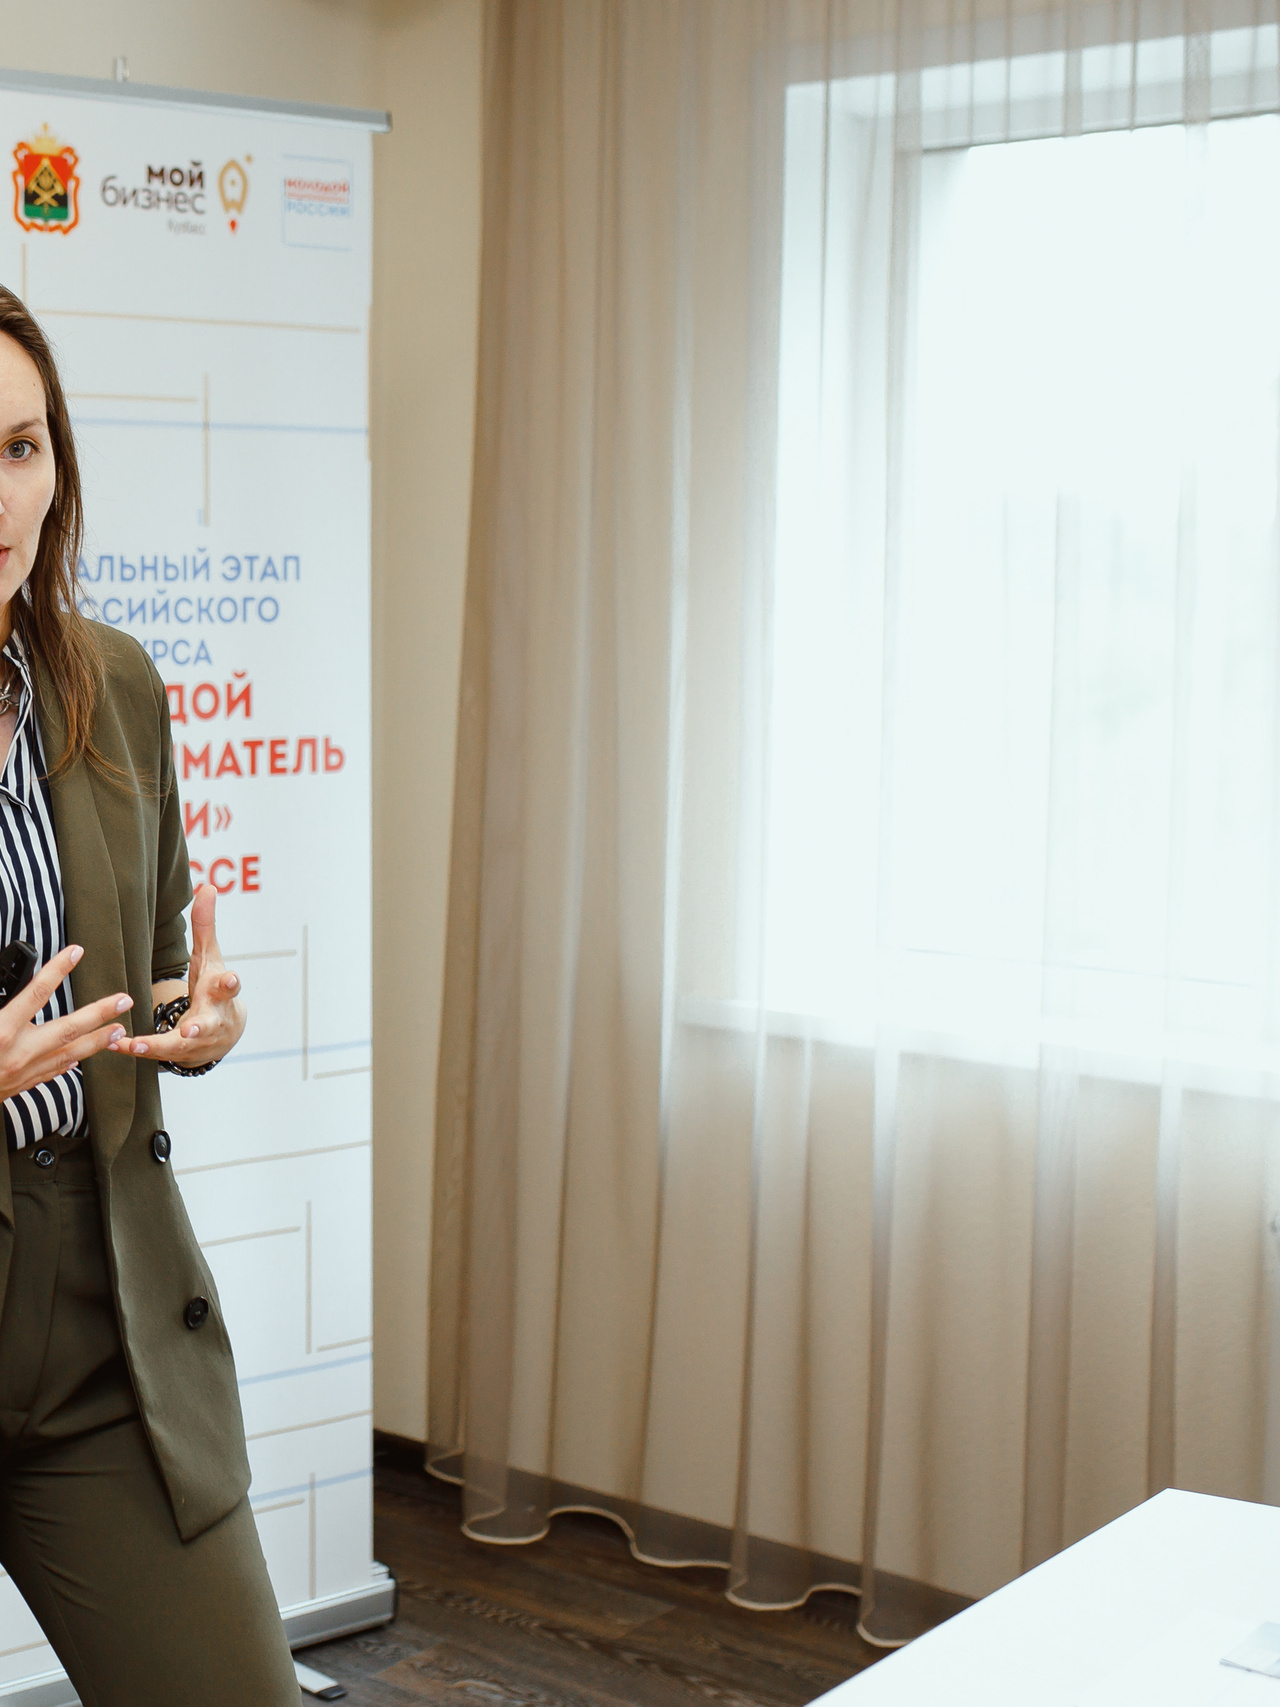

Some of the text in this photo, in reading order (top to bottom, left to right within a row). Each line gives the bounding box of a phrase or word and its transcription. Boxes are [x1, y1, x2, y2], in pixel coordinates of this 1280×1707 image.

[101, 175, 206, 214] бизнес
[63, 547, 301, 582] АЛЬНЫЙ ЭТАП
[173, 737, 345, 780] МАТЕЛЬ
